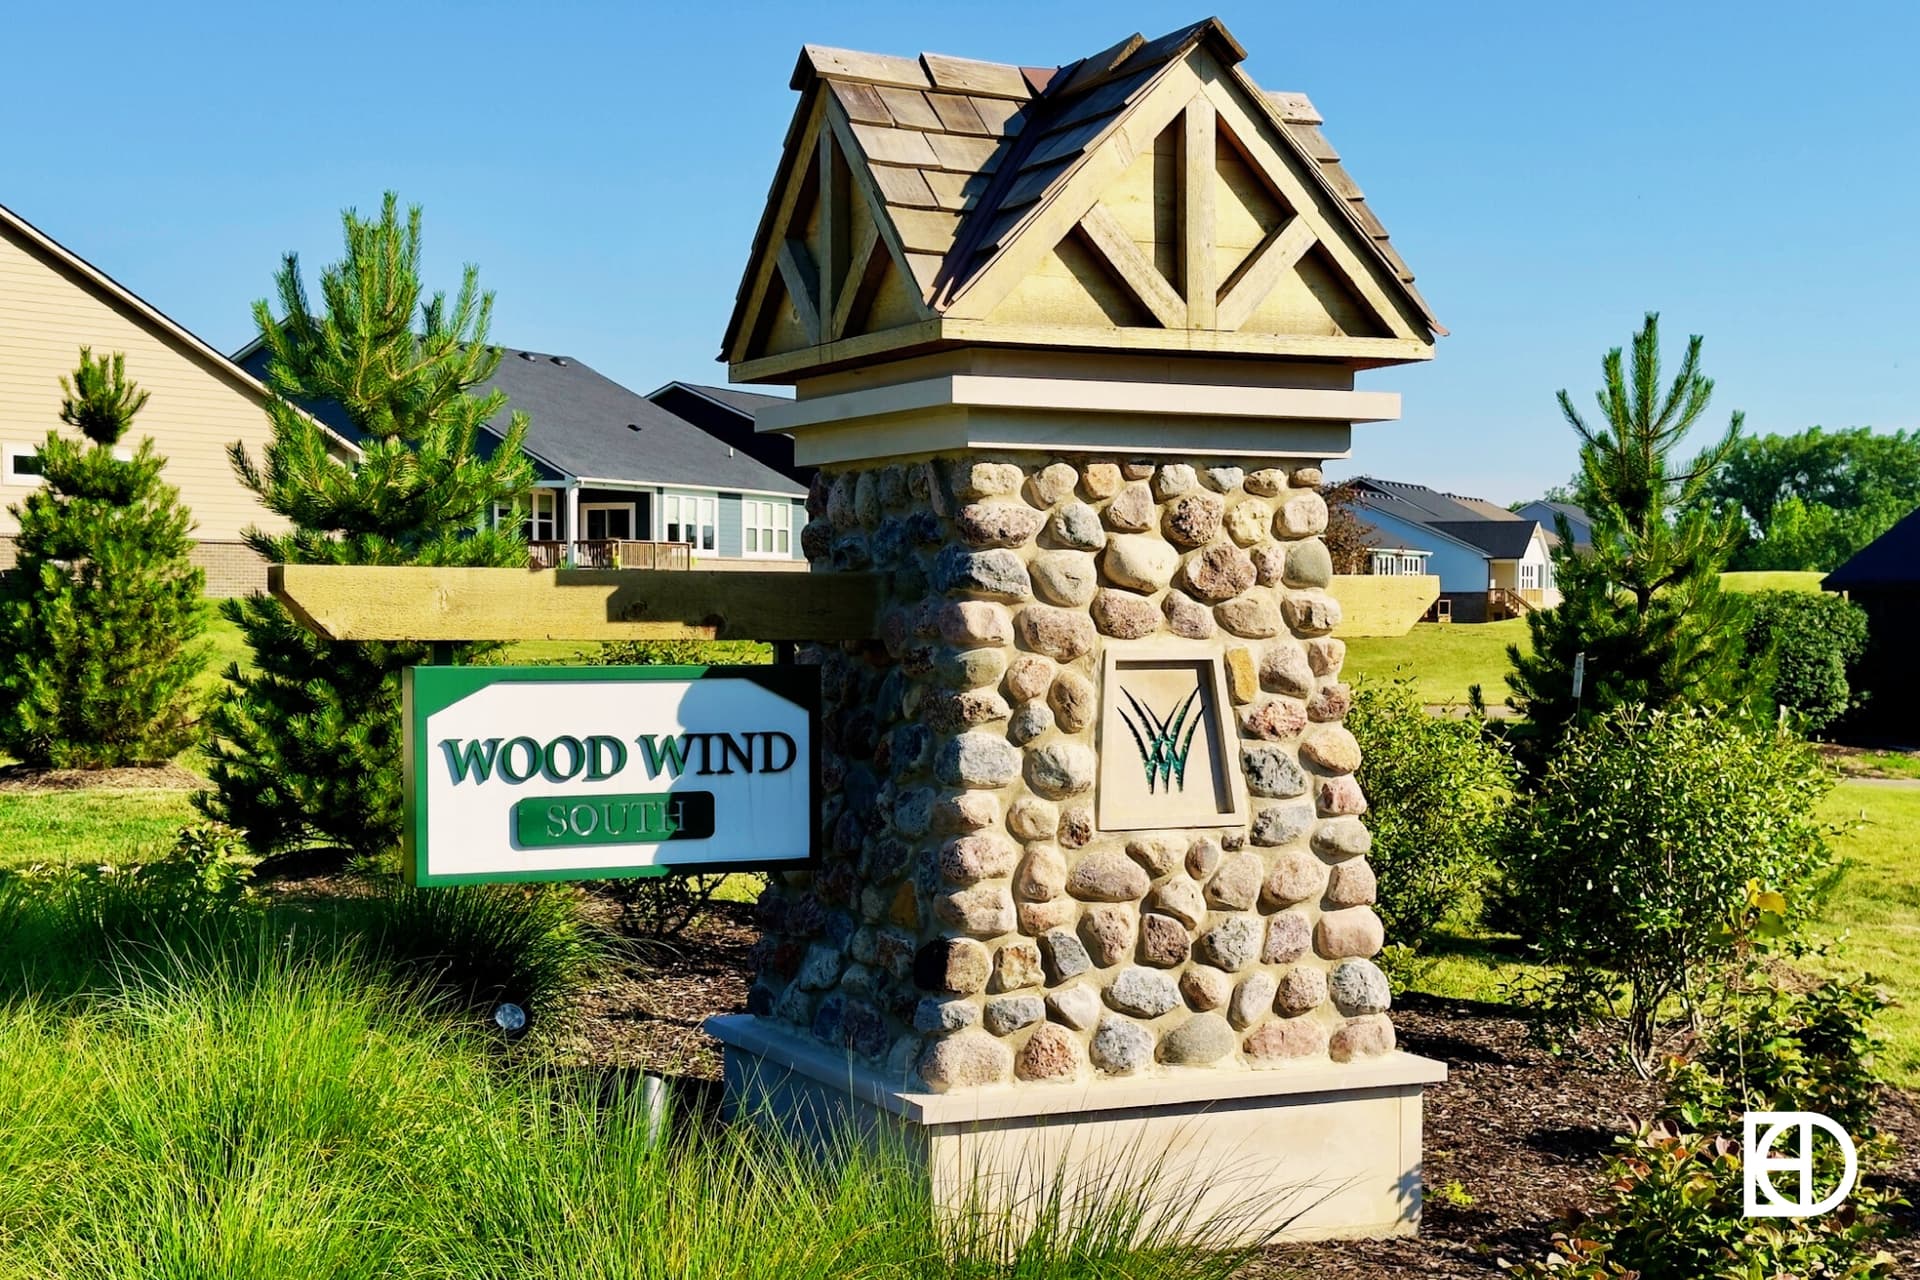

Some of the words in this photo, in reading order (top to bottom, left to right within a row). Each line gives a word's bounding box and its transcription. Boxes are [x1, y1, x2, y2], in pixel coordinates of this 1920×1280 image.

[438, 734, 628, 785] WOOD
[634, 730, 798, 780] WIND
[545, 799, 687, 838] SOUTH
